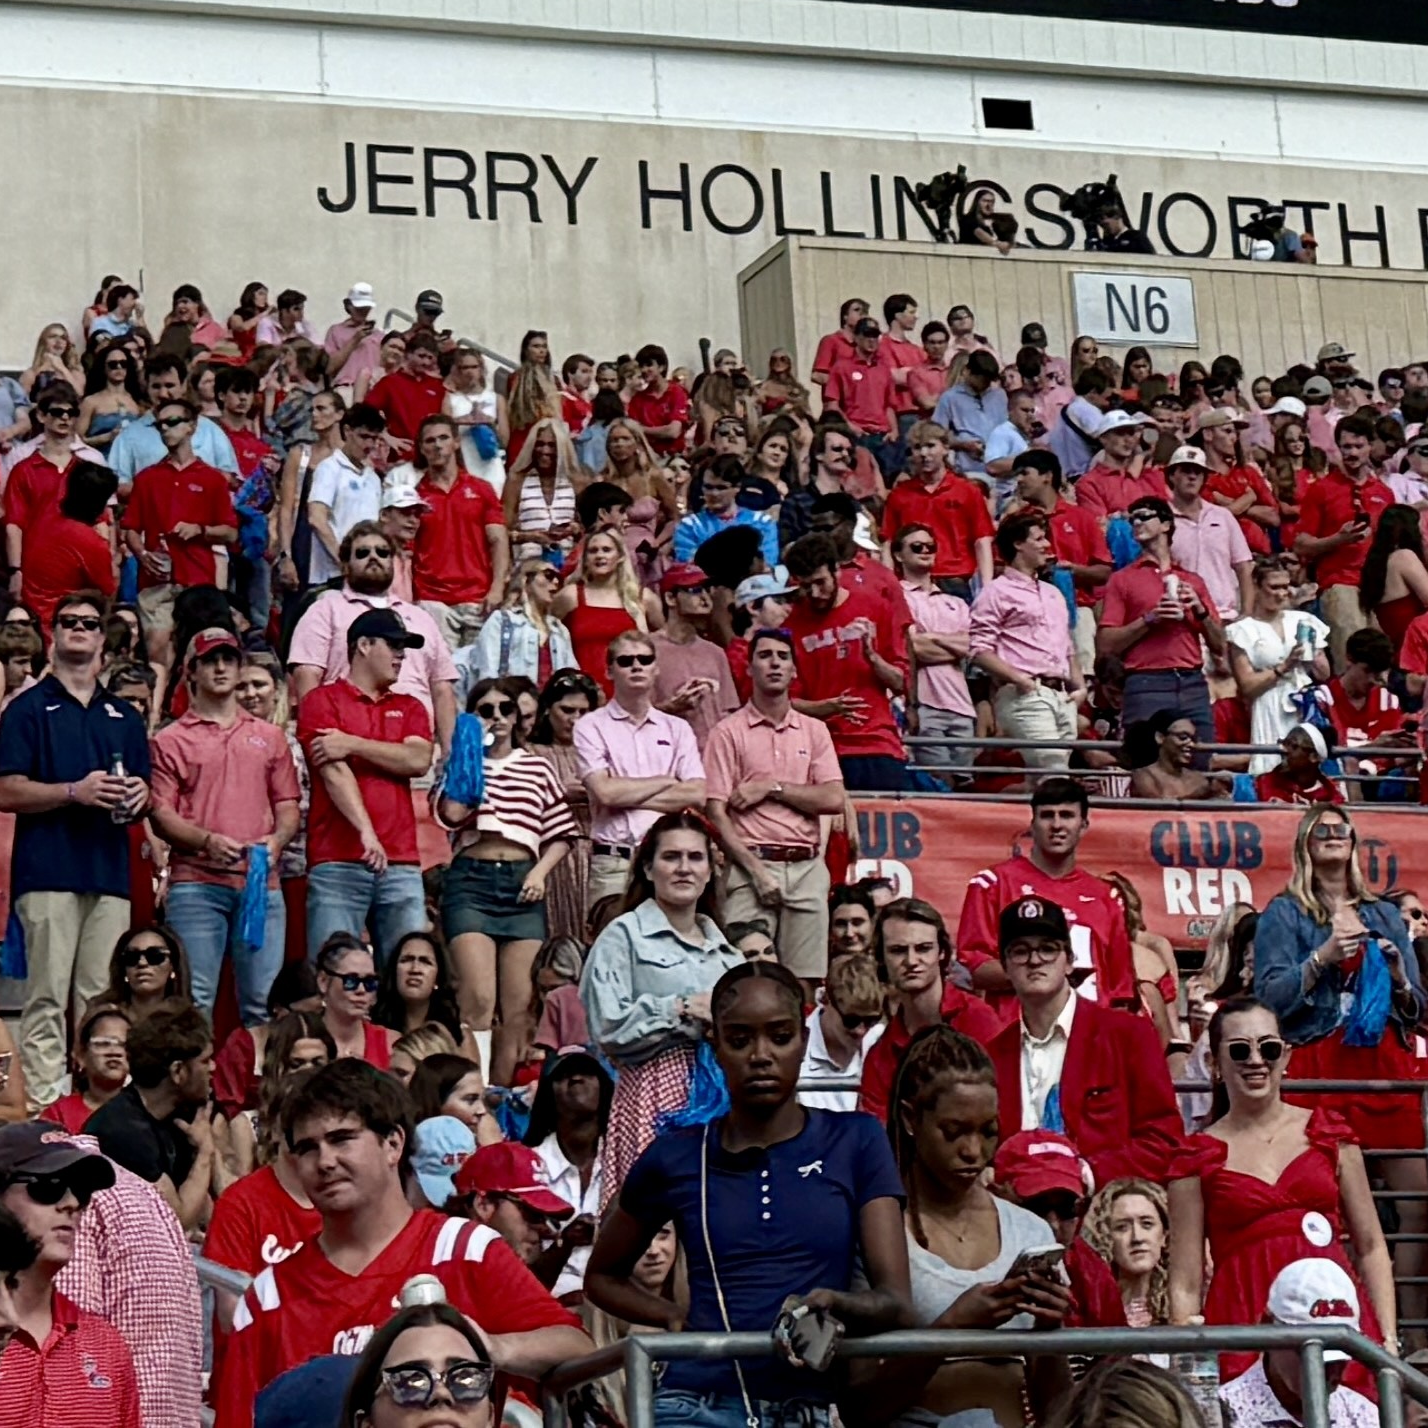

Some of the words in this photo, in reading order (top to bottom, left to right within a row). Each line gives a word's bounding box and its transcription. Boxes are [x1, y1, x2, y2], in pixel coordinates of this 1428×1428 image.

[317, 141, 598, 226] JERRY
[1104, 281, 1171, 335] N6
[858, 810, 924, 860] UB
[1150, 819, 1264, 871] CLUB
[845, 858, 913, 900] ED
[1162, 866, 1253, 917] RED
